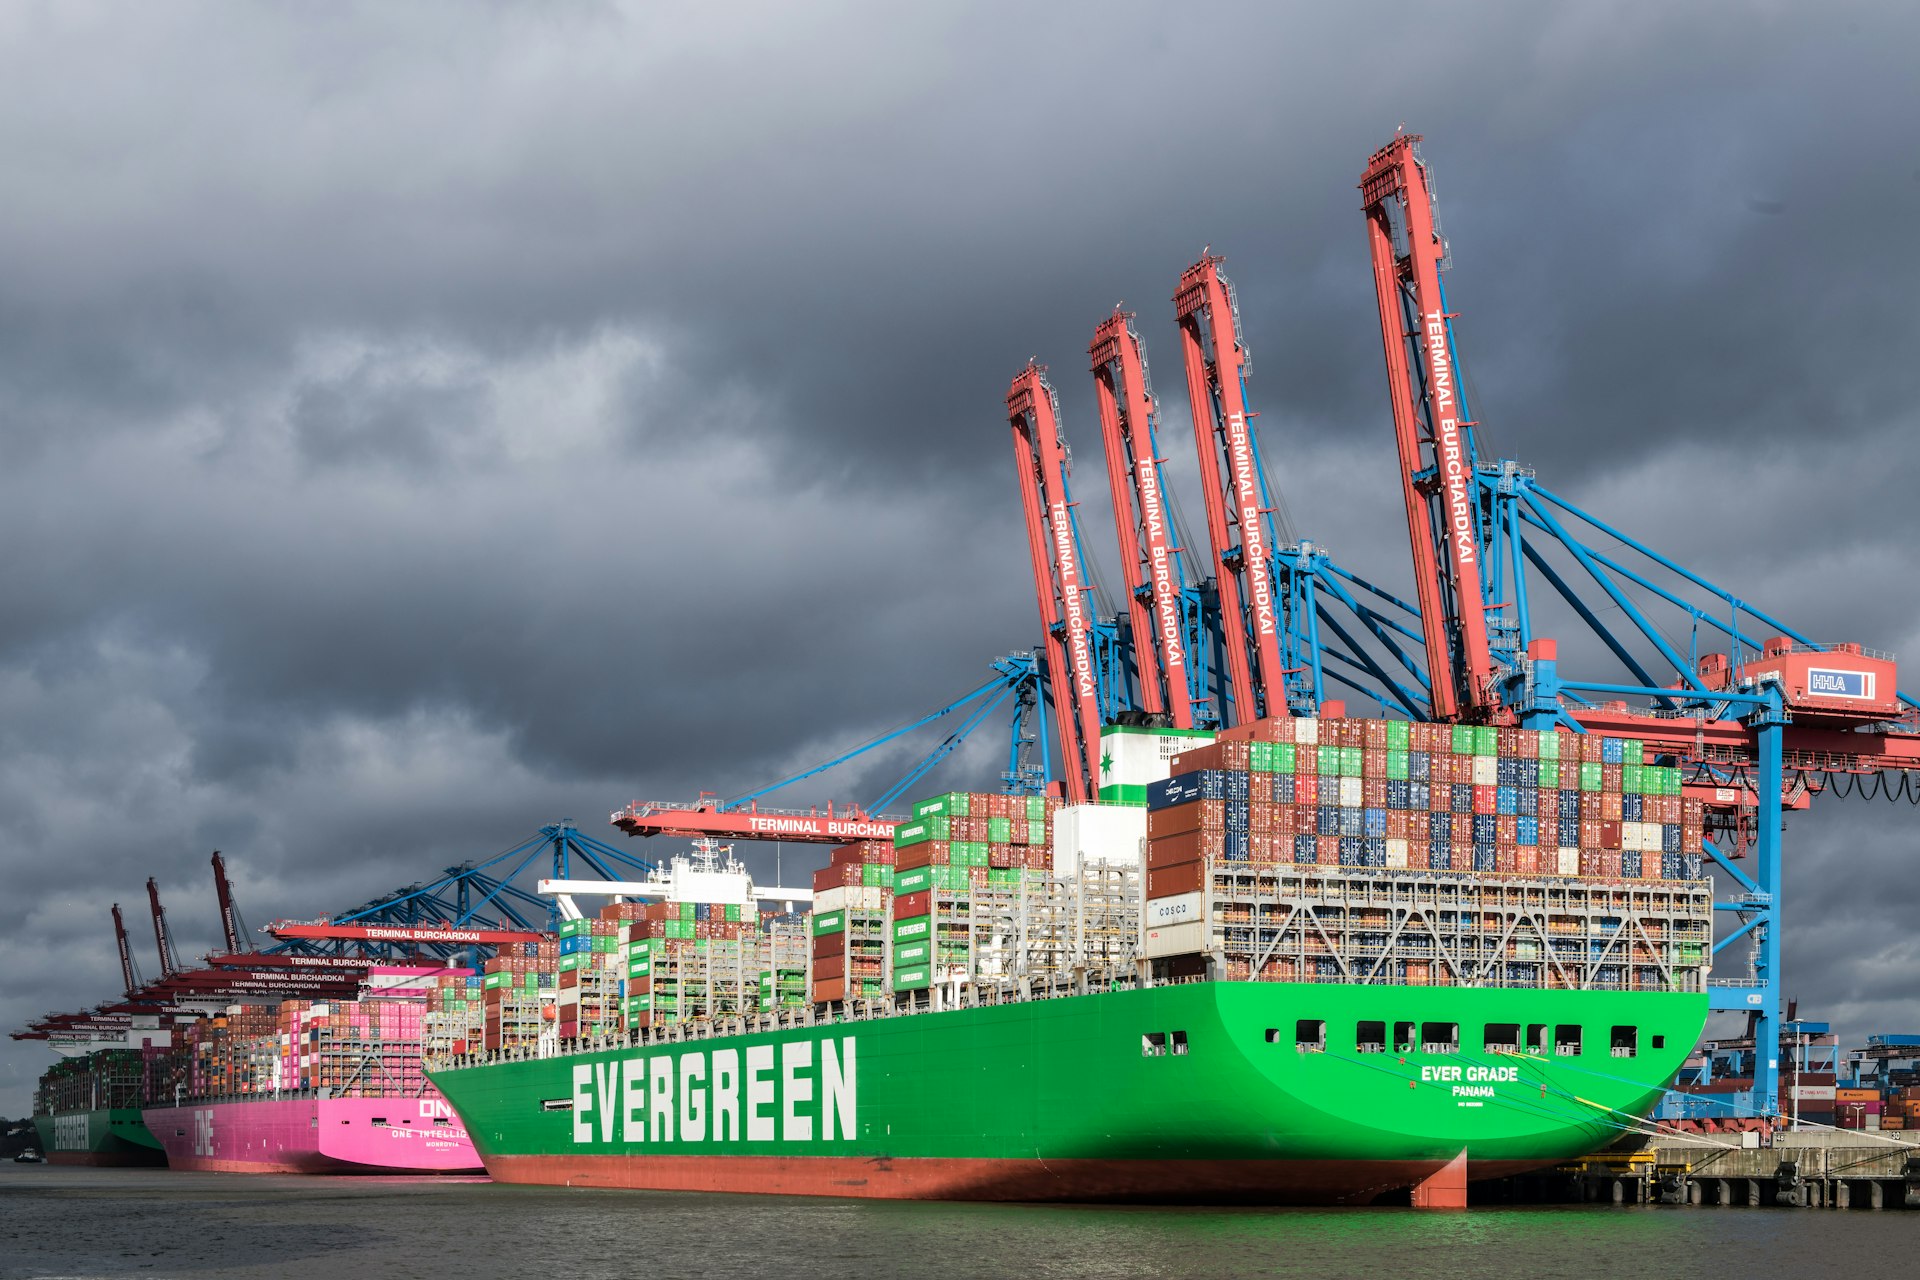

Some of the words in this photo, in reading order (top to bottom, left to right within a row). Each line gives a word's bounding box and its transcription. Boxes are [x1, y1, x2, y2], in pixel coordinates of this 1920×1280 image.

[1426, 309, 1453, 412] TERMINAL
[1442, 418, 1473, 564] BURCHARDKAI
[1230, 411, 1254, 501] TERMINAL
[1244, 507, 1273, 635] BURCHARDKAI
[1139, 457, 1163, 541] TERMINAL
[1153, 547, 1181, 666] BURCHARDKAI
[1053, 501, 1071, 580] TERMINAL
[1066, 585, 1093, 697] BURCHARDKAI
[1813, 675, 1845, 691] HHLA
[749, 818, 820, 833] TERMINAL
[828, 822, 894, 836] BURCHAR
[1160, 904, 1187, 917] COSCO
[366, 929, 412, 938] TERMINAL
[414, 931, 480, 940] BURCHARDKAI
[898, 922, 926, 937] EVERGREEN
[290, 957, 331, 966] TERMINAL
[251, 972, 289, 980] TERMINAL
[291, 974, 345, 982] BURCHARDKAI
[1421, 1066, 1461, 1081] EVER
[1467, 1067, 1519, 1081] GRADE
[573, 1036, 857, 1143] EVERGREEN
[1452, 1086, 1495, 1097] PANAMA
[420, 1100, 456, 1117] ON
[194, 1109, 214, 1156] ONE
[392, 1130, 412, 1138] ONE
[420, 1130, 467, 1138] INTELLIG
